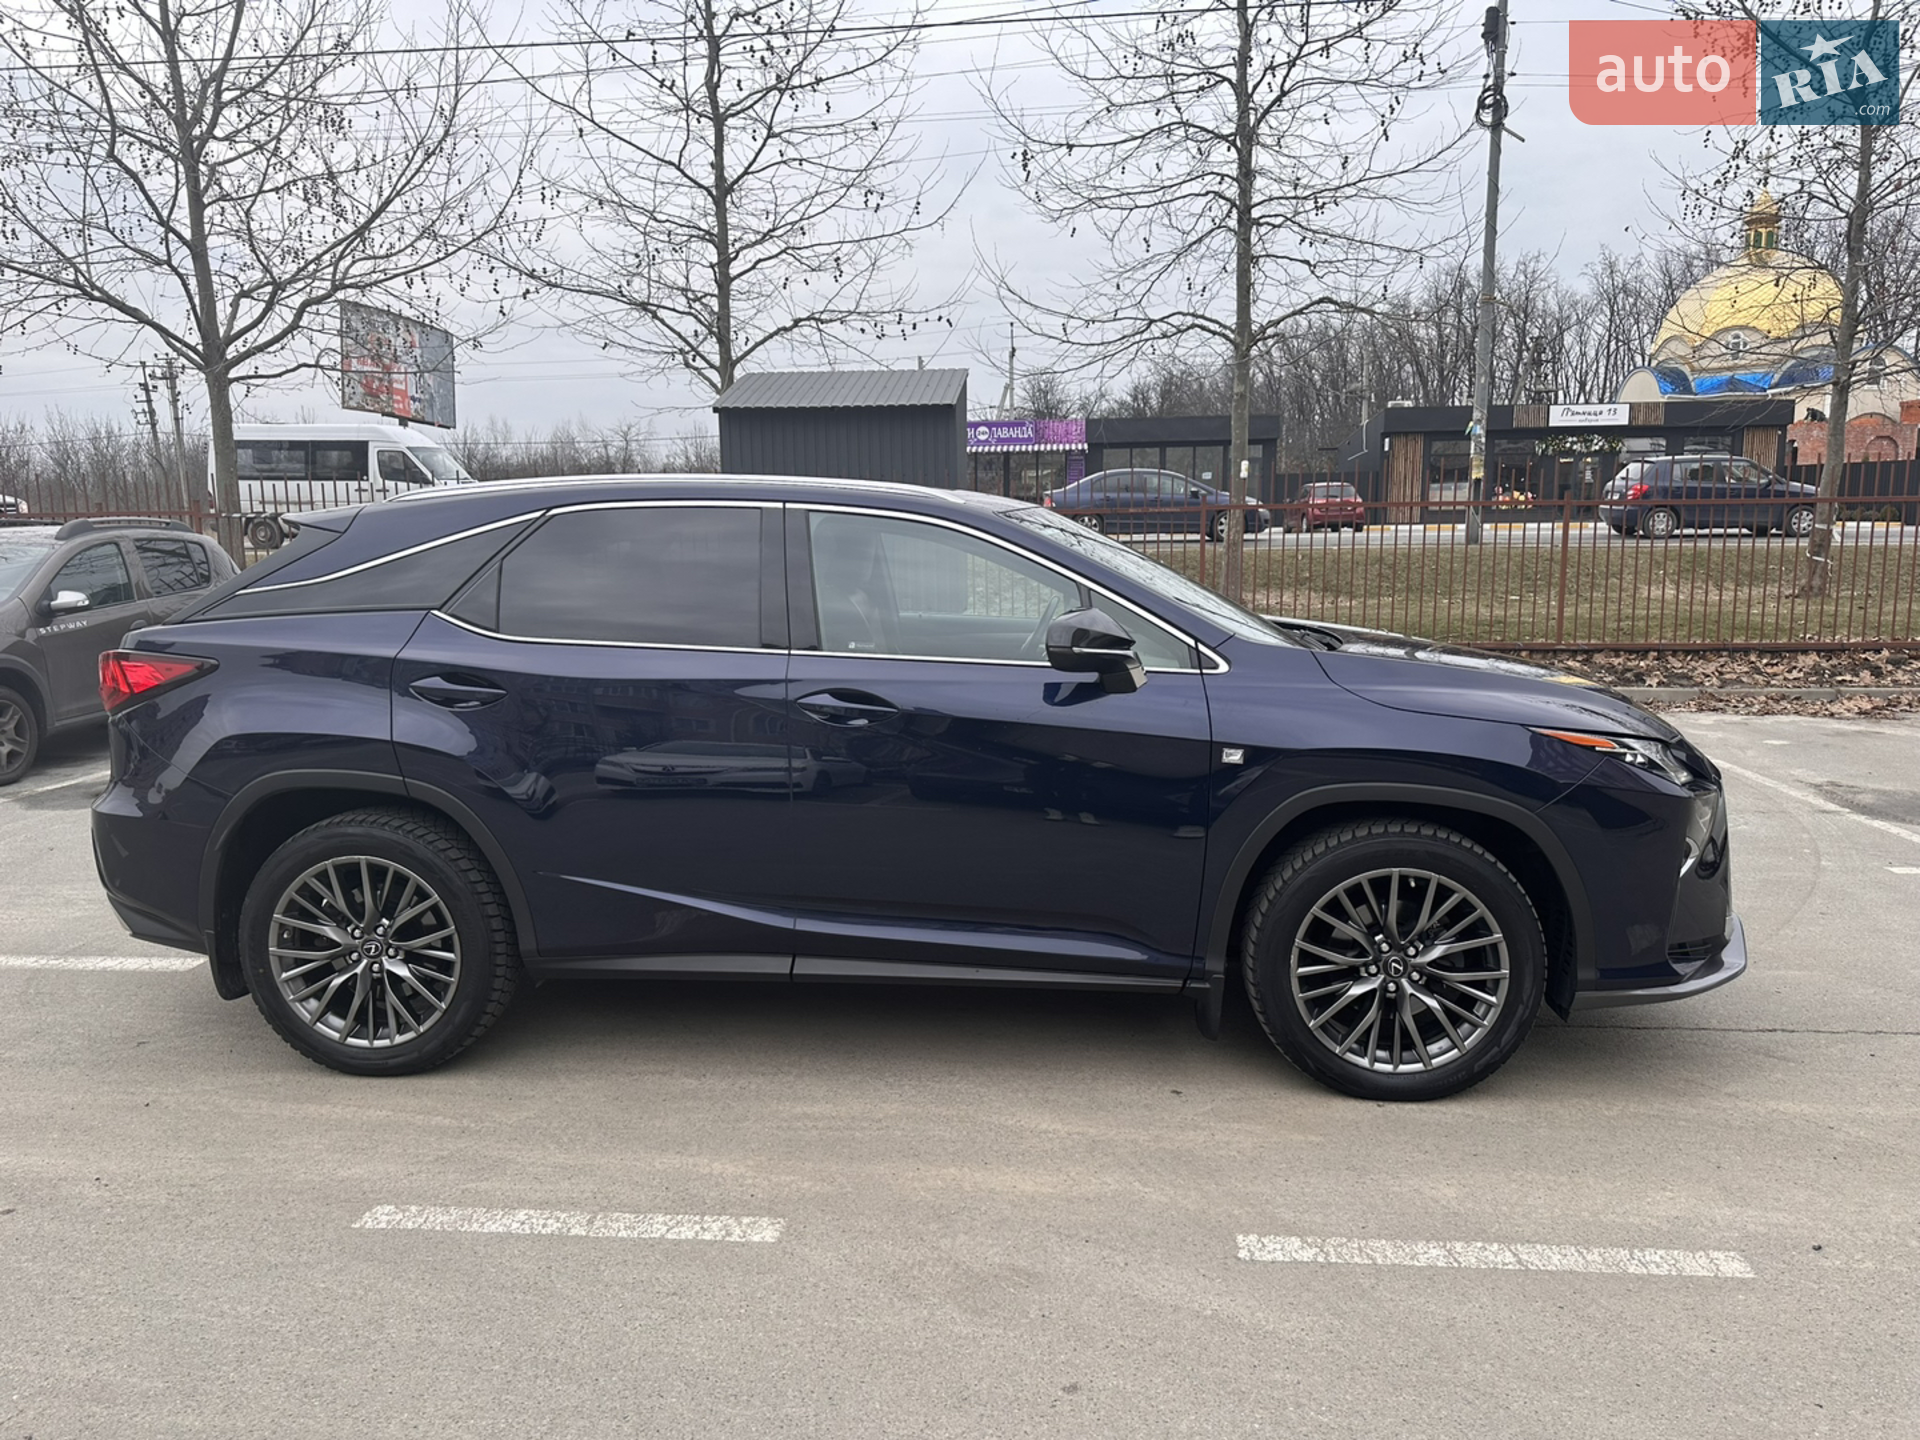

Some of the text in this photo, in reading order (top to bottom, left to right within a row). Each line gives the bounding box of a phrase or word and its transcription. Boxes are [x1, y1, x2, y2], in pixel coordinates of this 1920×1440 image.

[1607, 407, 1618, 416] 13
[990, 426, 1033, 439] ЛАВАНДА
[39, 620, 88, 634] STEPWAY
